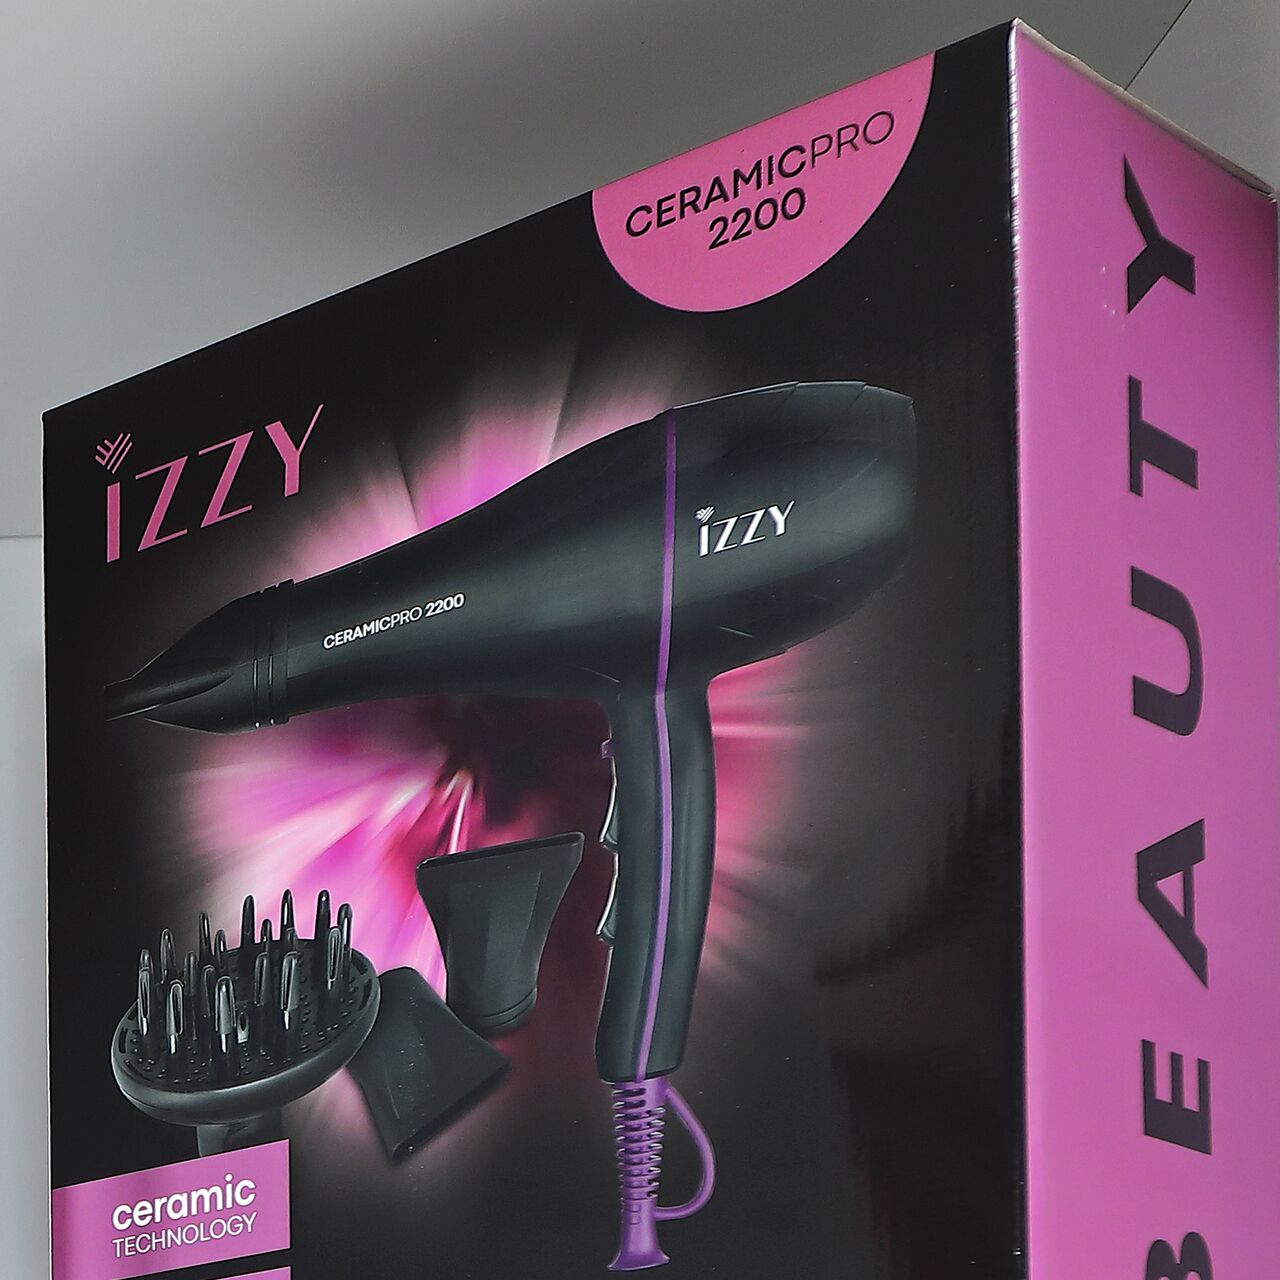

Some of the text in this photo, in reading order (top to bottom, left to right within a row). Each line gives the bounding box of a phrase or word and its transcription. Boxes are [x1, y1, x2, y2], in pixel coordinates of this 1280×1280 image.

[624, 110, 896, 237] CERAMICPRO
[707, 187, 807, 250] 2200
[323, 593, 465, 649] CERAMICPRO 2200
[111, 1173, 256, 1232] ceramic
[112, 1212, 257, 1259] TECHNOLOGY
